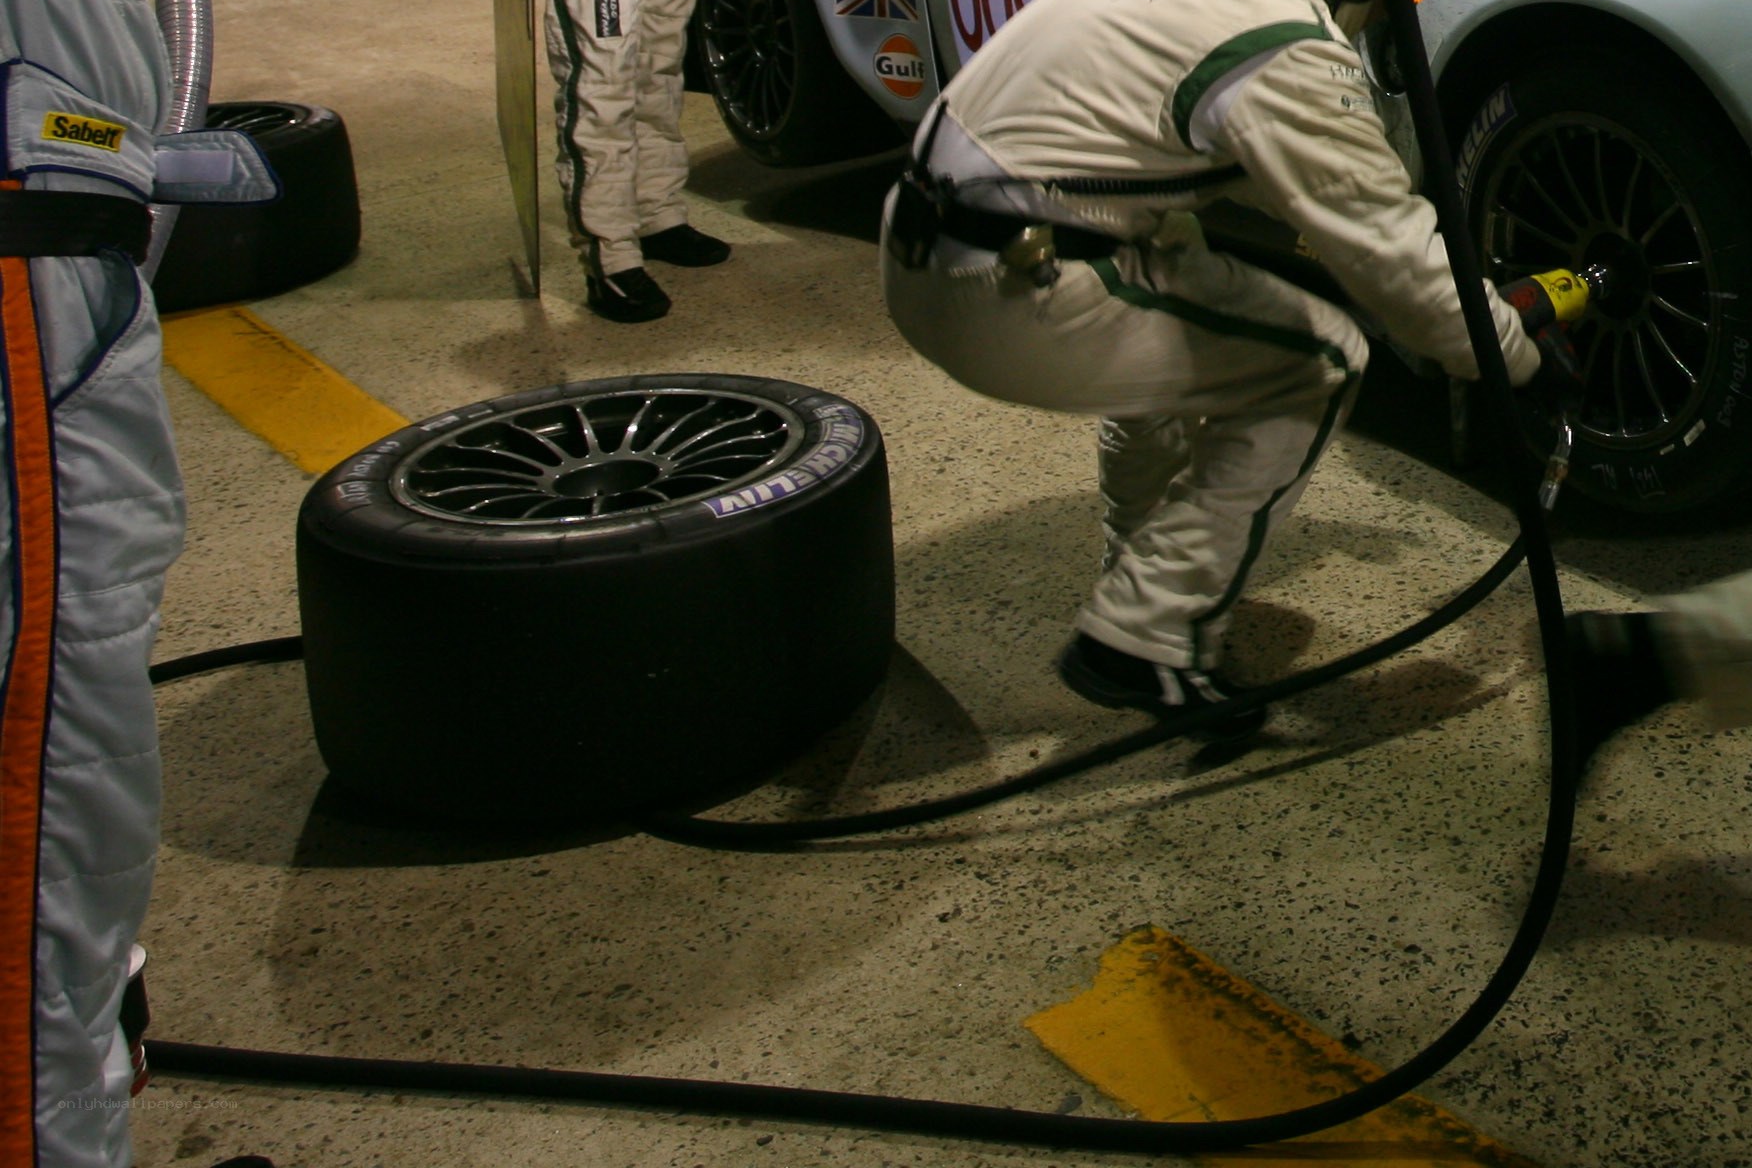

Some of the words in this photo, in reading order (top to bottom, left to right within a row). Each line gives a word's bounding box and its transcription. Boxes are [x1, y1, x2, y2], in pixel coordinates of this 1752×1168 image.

[876, 55, 925, 80] Gulf
[52, 115, 118, 149] Sabelt
[719, 423, 863, 514] MICHELIN
